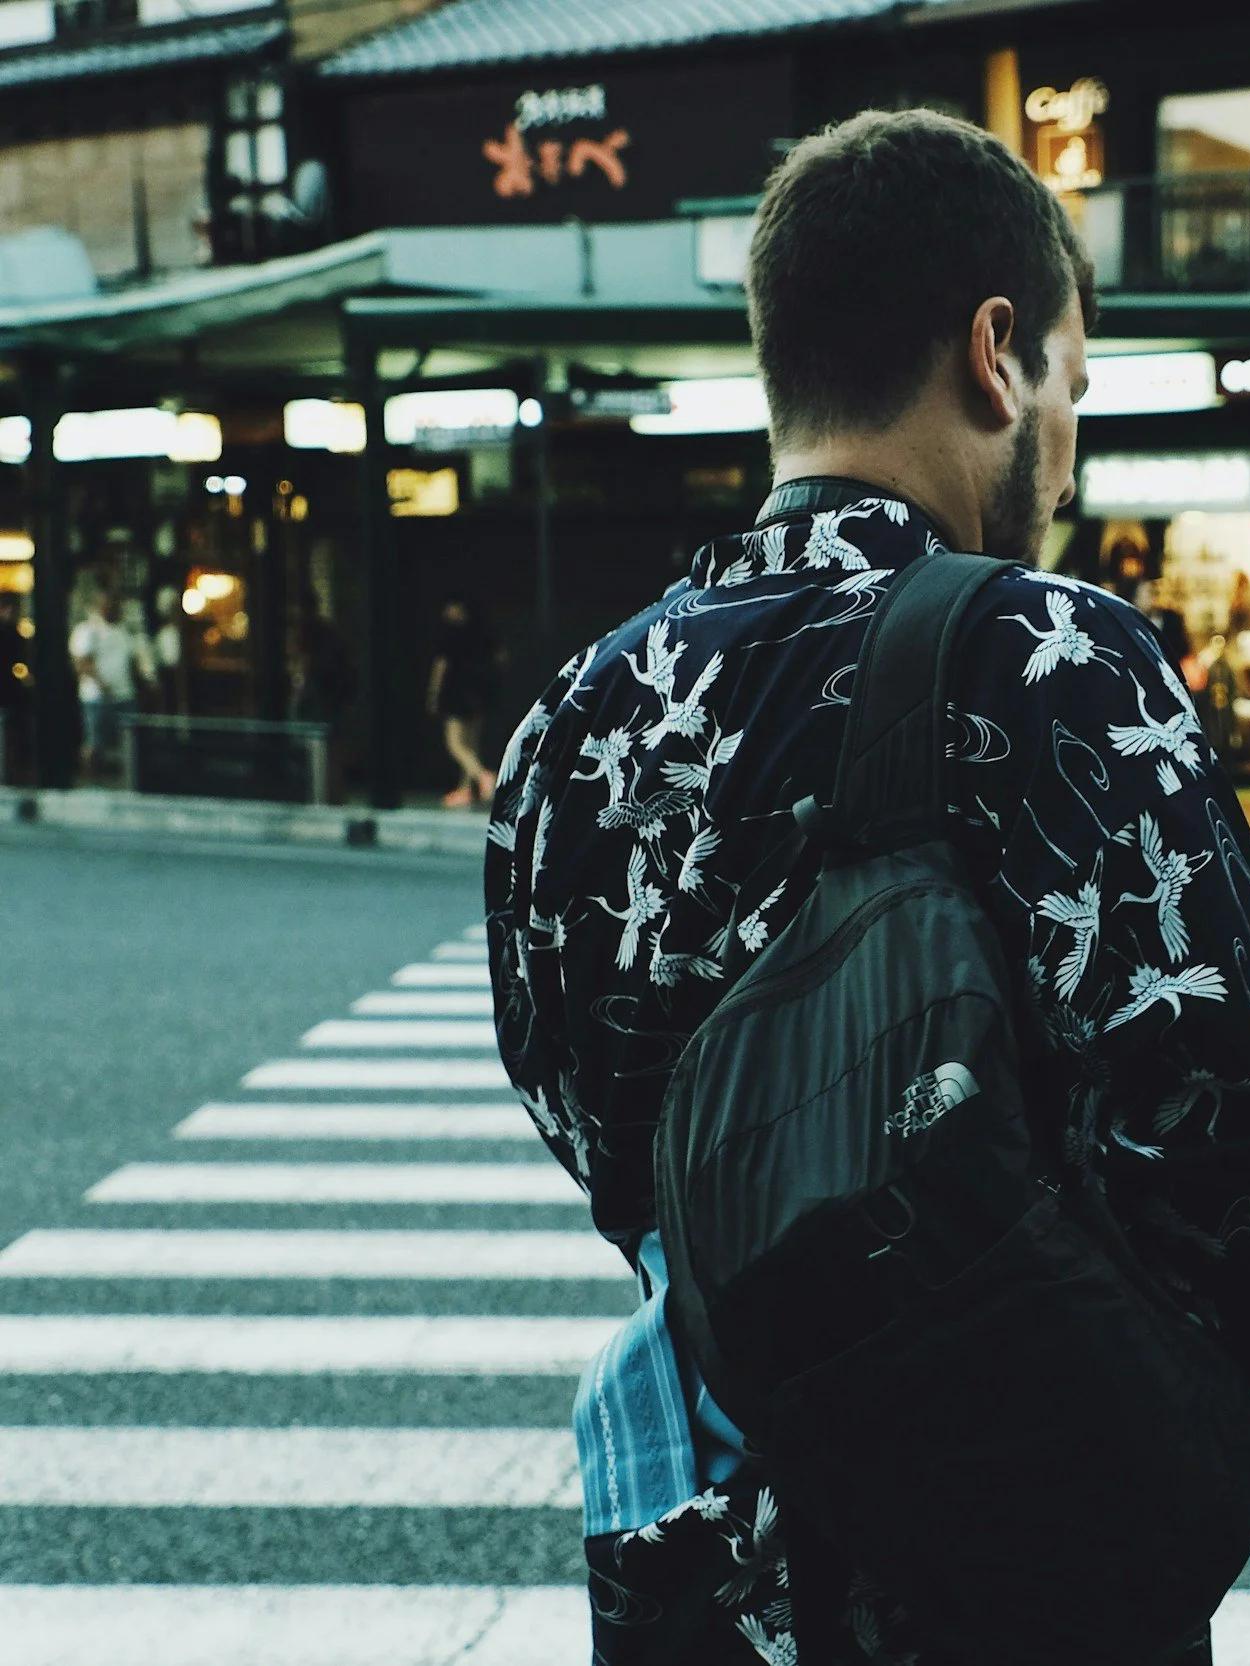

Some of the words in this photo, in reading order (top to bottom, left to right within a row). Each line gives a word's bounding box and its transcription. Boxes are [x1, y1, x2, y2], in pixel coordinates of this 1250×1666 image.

[902, 1072, 938, 1101] THE
[884, 1086, 942, 1135] NORTH
[902, 1100, 947, 1138] FACE
